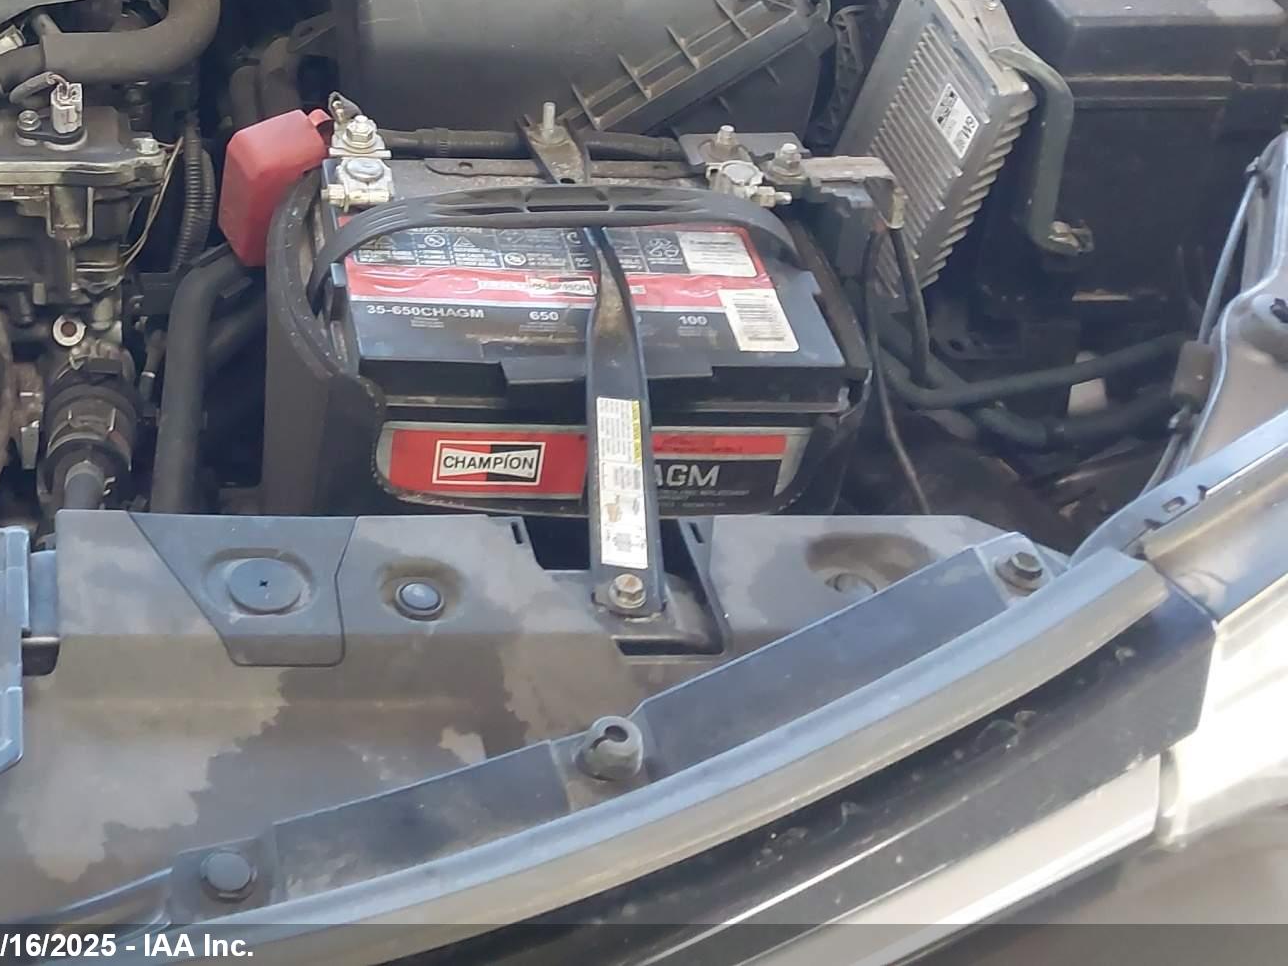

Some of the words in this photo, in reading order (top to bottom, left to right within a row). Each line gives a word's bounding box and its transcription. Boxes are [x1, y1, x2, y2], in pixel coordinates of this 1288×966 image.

[366, 305, 485, 319] 35-650CHAGM
[528, 310, 560, 321] 650
[678, 314, 708, 326] 100
[443, 454, 535, 470] CHAMPION
